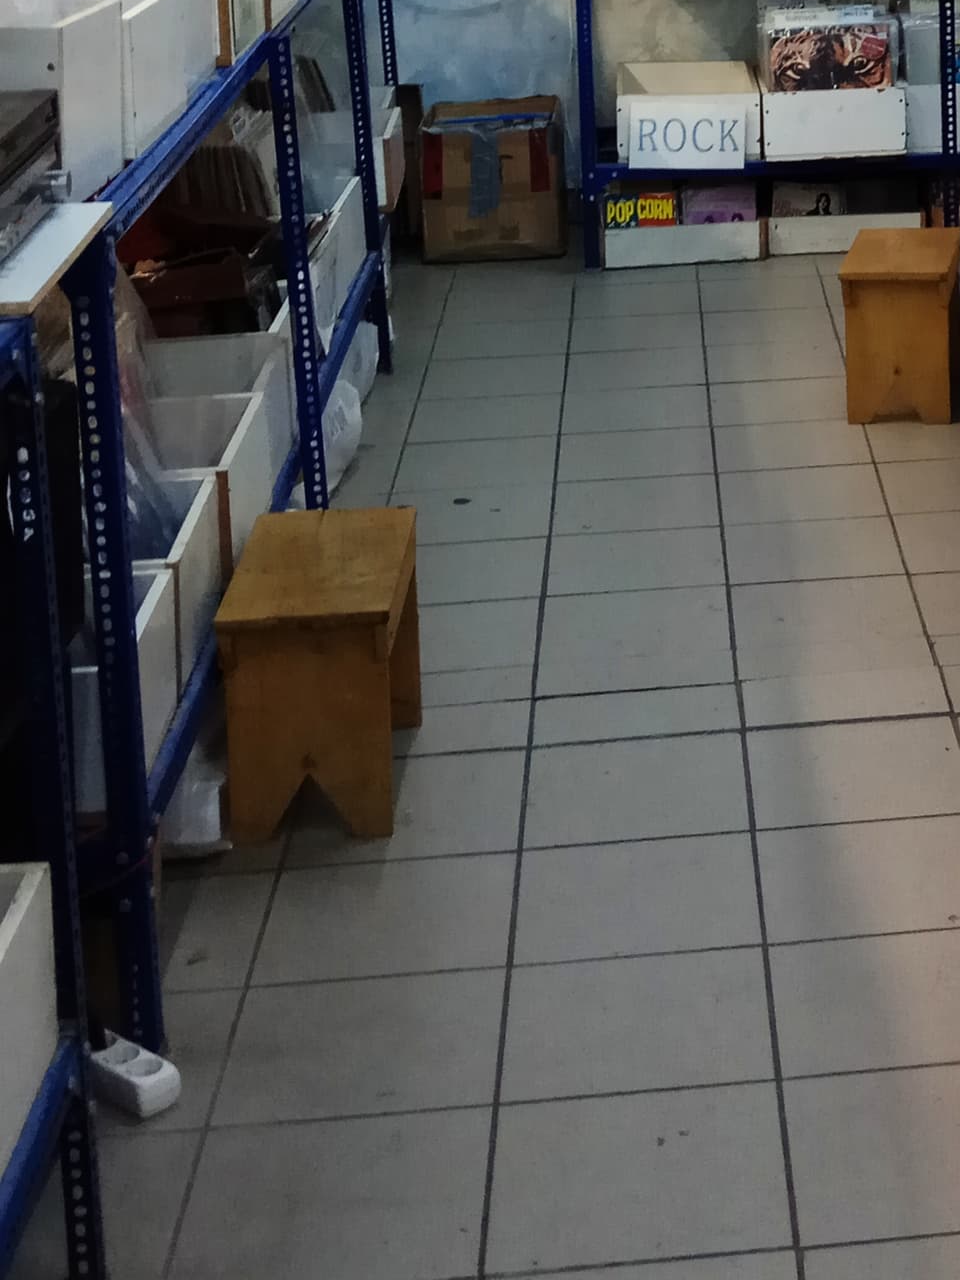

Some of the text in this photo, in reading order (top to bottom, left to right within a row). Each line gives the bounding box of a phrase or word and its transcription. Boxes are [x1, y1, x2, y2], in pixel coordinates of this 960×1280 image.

[637, 118, 741, 154] ROCK
[606, 198, 675, 224] POP CORN
